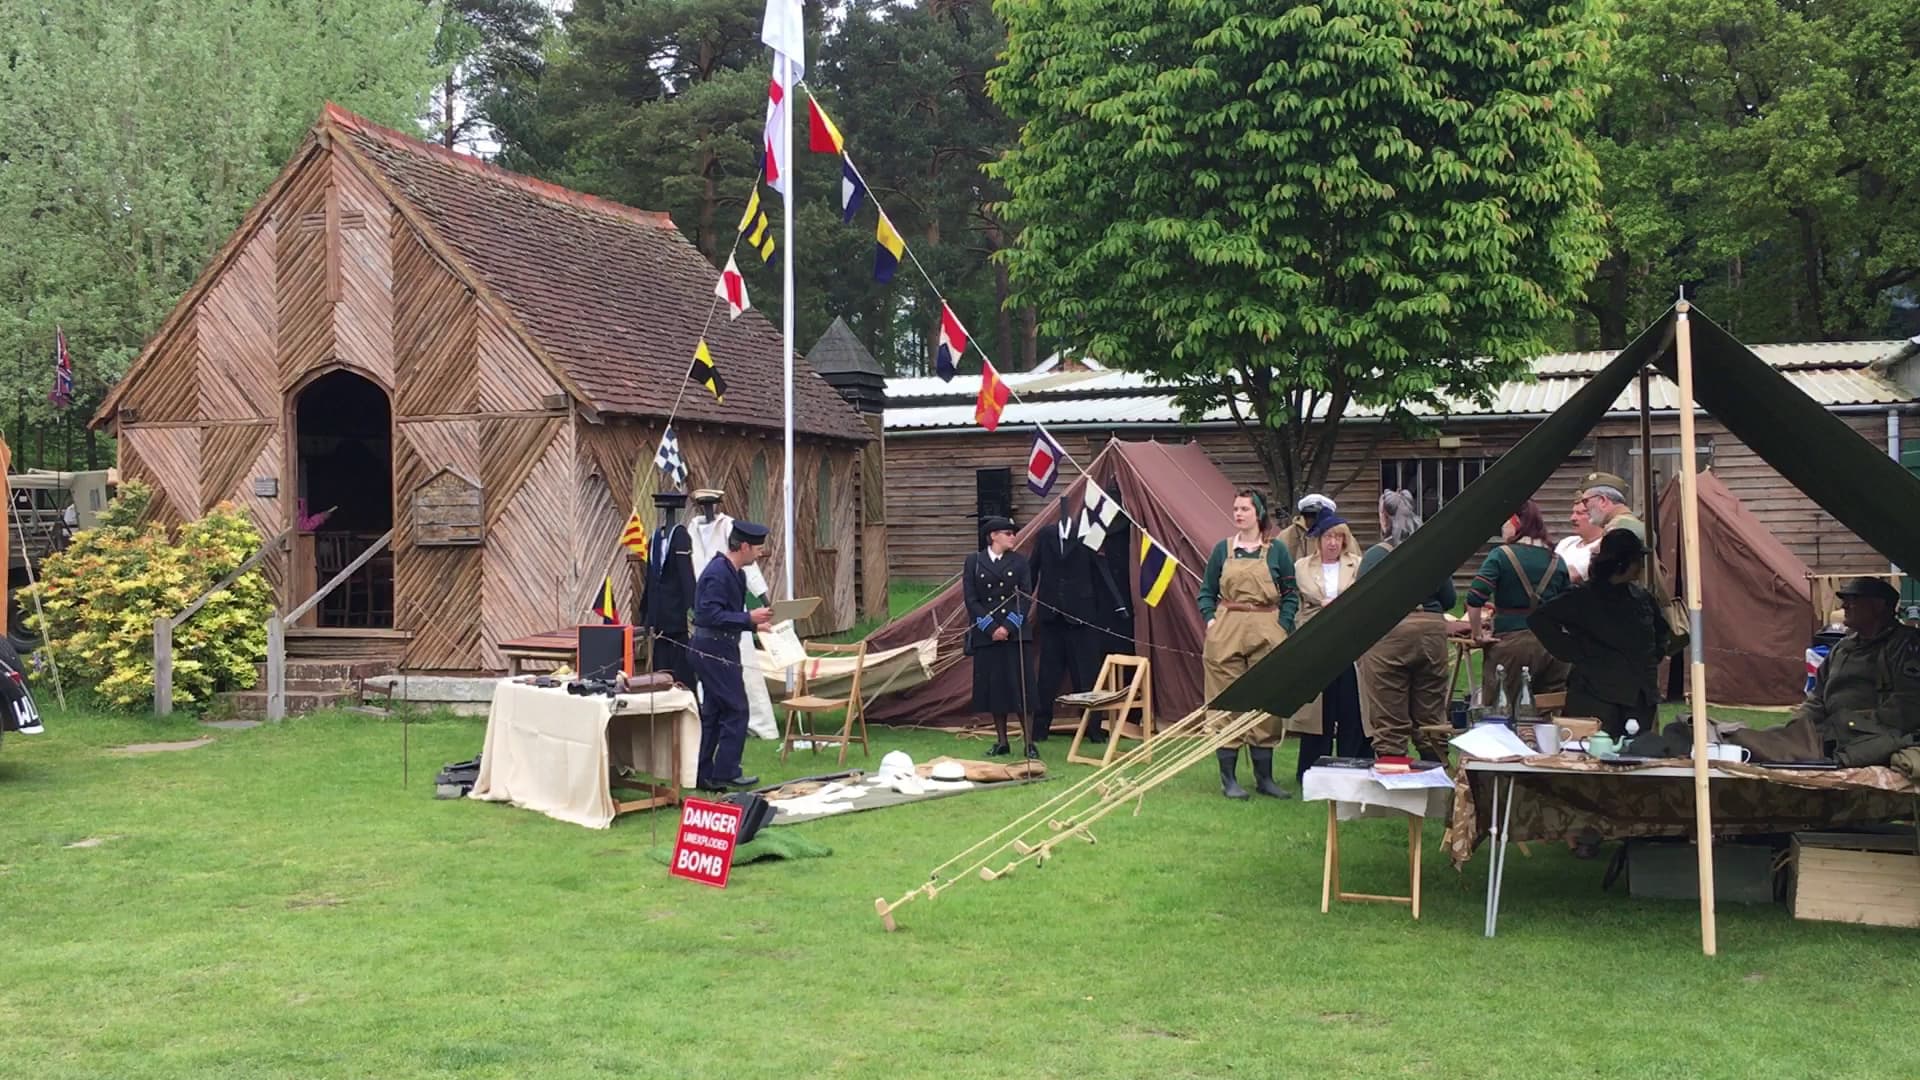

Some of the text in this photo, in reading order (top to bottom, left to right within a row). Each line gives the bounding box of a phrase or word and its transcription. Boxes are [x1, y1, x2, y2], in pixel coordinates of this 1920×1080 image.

[683, 807, 737, 835] DANGER
[684, 832, 729, 851] UNEXPLODED
[677, 848, 723, 877] BOMB
